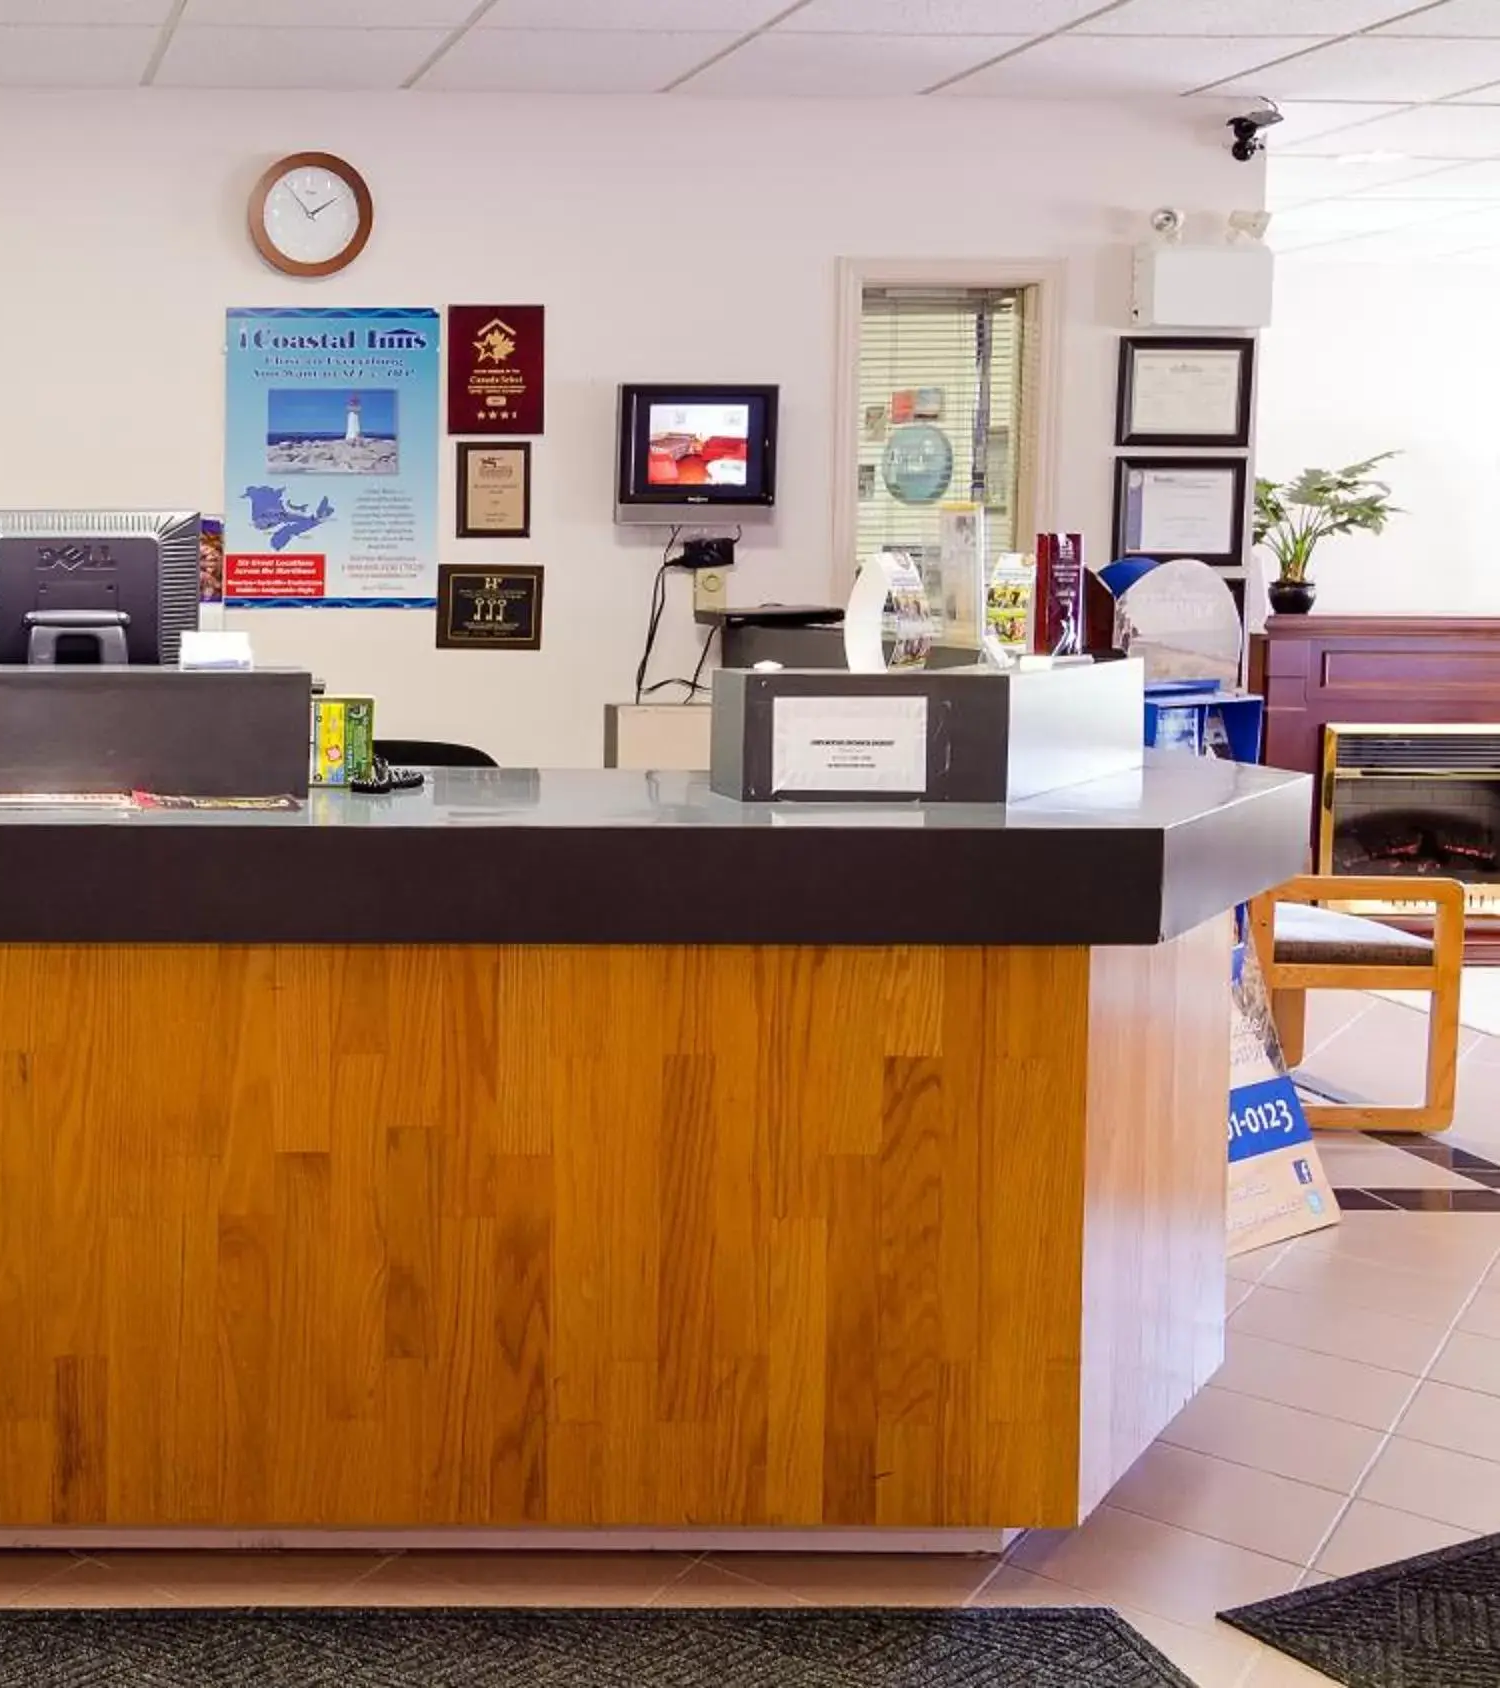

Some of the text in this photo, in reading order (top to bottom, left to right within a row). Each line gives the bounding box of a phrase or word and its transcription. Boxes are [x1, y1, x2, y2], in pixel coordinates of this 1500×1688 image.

[367, 327, 427, 349] Inns
[469, 376, 523, 384] Canada Select
[35, 544, 118, 571] DELL
